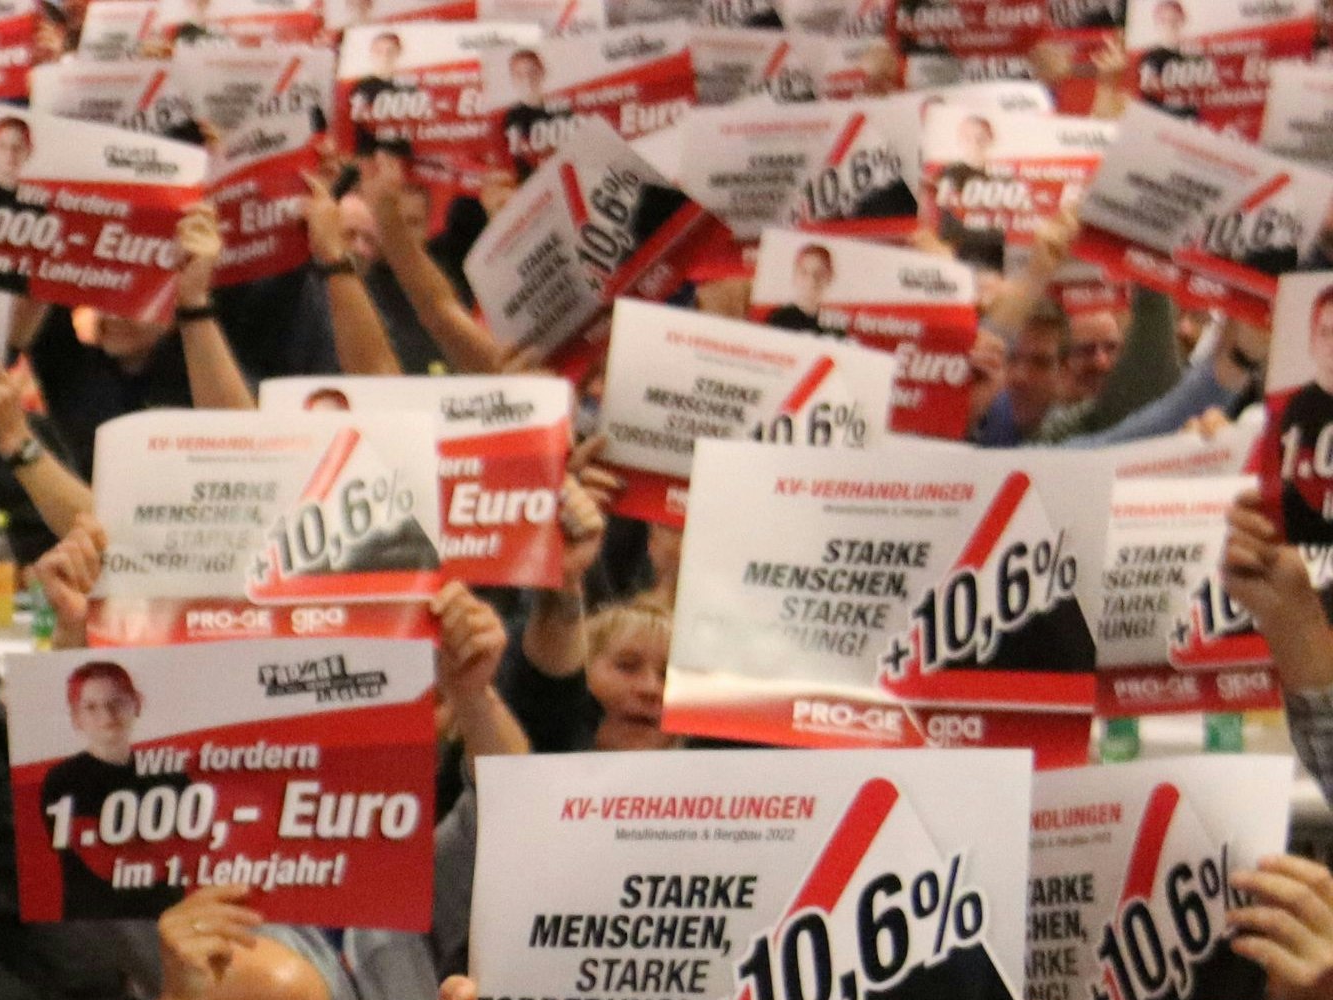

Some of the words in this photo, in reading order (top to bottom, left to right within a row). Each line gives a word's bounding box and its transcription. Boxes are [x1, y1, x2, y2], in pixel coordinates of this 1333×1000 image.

[448, 483, 558, 525] Euro
[774, 475, 976, 502] KV-VERHANDLUNGEN
[250, 469, 414, 580] +10,6%
[823, 538, 932, 568] STARKE
[743, 561, 909, 600] MENSCHEN,
[779, 596, 891, 630] STARKE
[883, 528, 1079, 676] +10,6%
[928, 713, 983, 746] gpa
[134, 745, 191, 777] Wir
[199, 742, 320, 771] fordern
[45, 783, 261, 850] 1.000,-
[278, 781, 419, 839] Euro
[560, 796, 816, 821] KV-VERHANDLUNGEN
[713, 828, 762, 844] Bergbau
[765, 828, 796, 842] 2022
[196, 853, 347, 892] Lehrjahr!
[620, 875, 758, 909] STARKE
[529, 914, 732, 957] MENSCHEN,
[576, 958, 711, 994] STARKE
